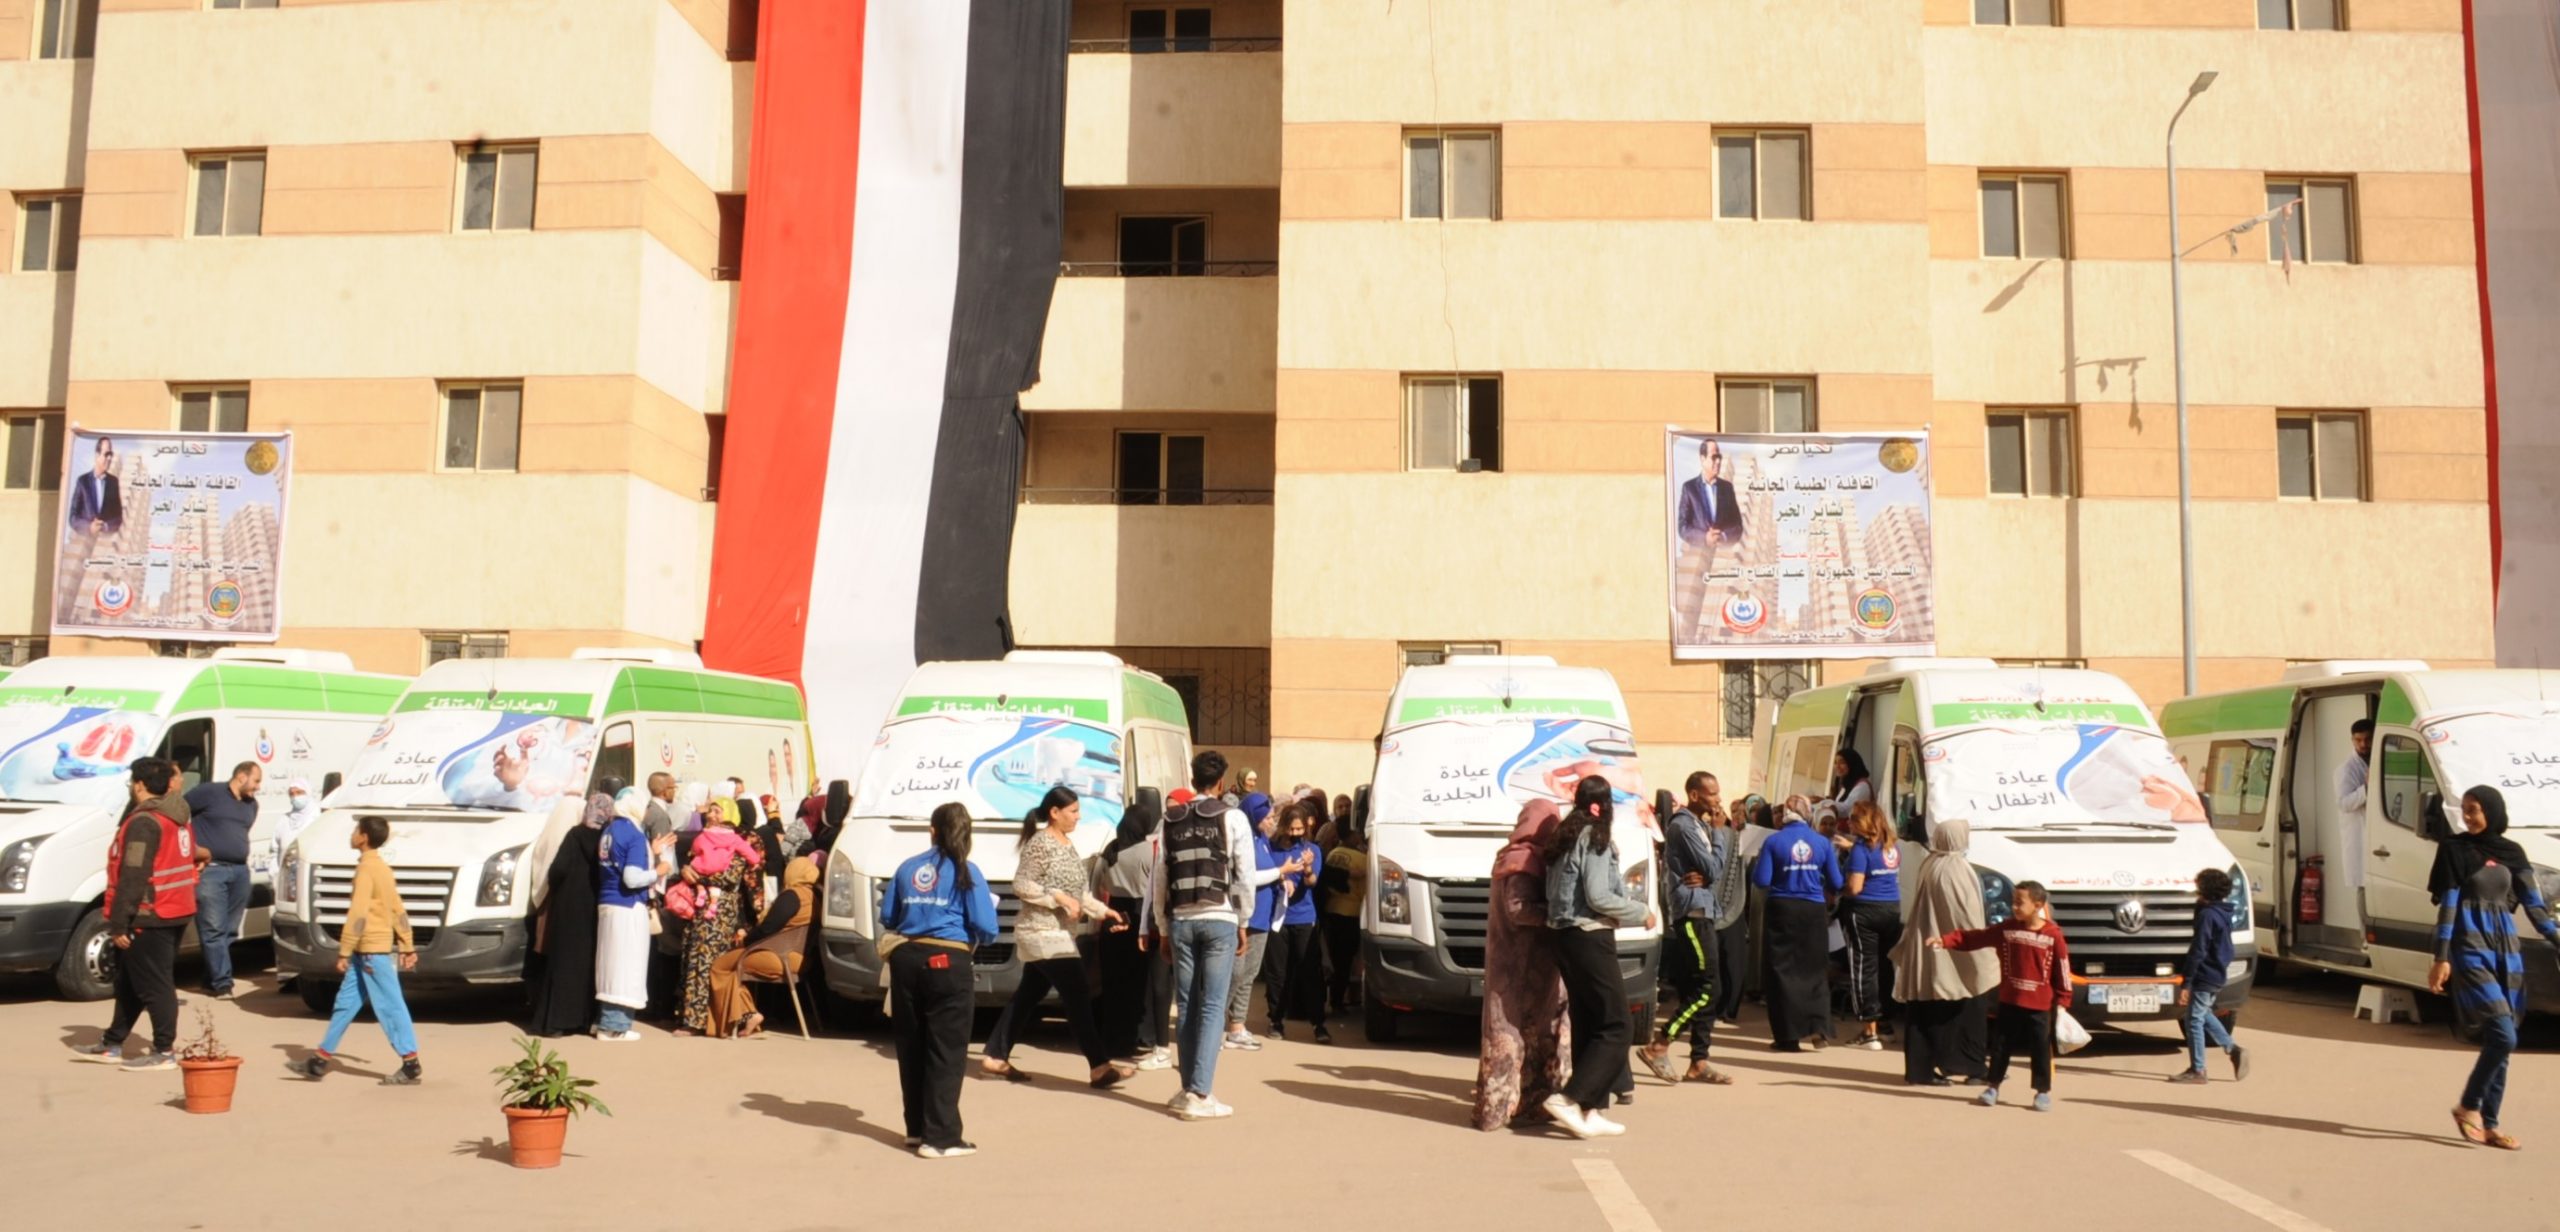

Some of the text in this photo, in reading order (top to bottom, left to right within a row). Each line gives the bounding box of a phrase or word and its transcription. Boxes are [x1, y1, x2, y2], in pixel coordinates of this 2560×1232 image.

[153, 440, 208, 458] تحيا مصر
[1768, 440, 1834, 459] تحيا مصر
[169, 473, 202, 492] الطبية
[205, 474, 241, 491] القافلة
[1747, 474, 1879, 494] القافلة الطبية المجانية
[150, 499, 177, 516] الخير
[1776, 502, 1806, 522] الخير
[424, 696, 559, 714] العيادات المتنقلة
[394, 752, 437, 768] عيادة
[916, 756, 964, 774] عيادة
[2508, 751, 2560, 768] عيادة
[357, 772, 430, 788] المسالك
[1440, 764, 1491, 782] عيادة
[1998, 770, 2049, 787] عيادة
[890, 778, 960, 796] الاسنان
[1422, 785, 1491, 807] الجلدية
[1987, 792, 2056, 812] الاطفال
